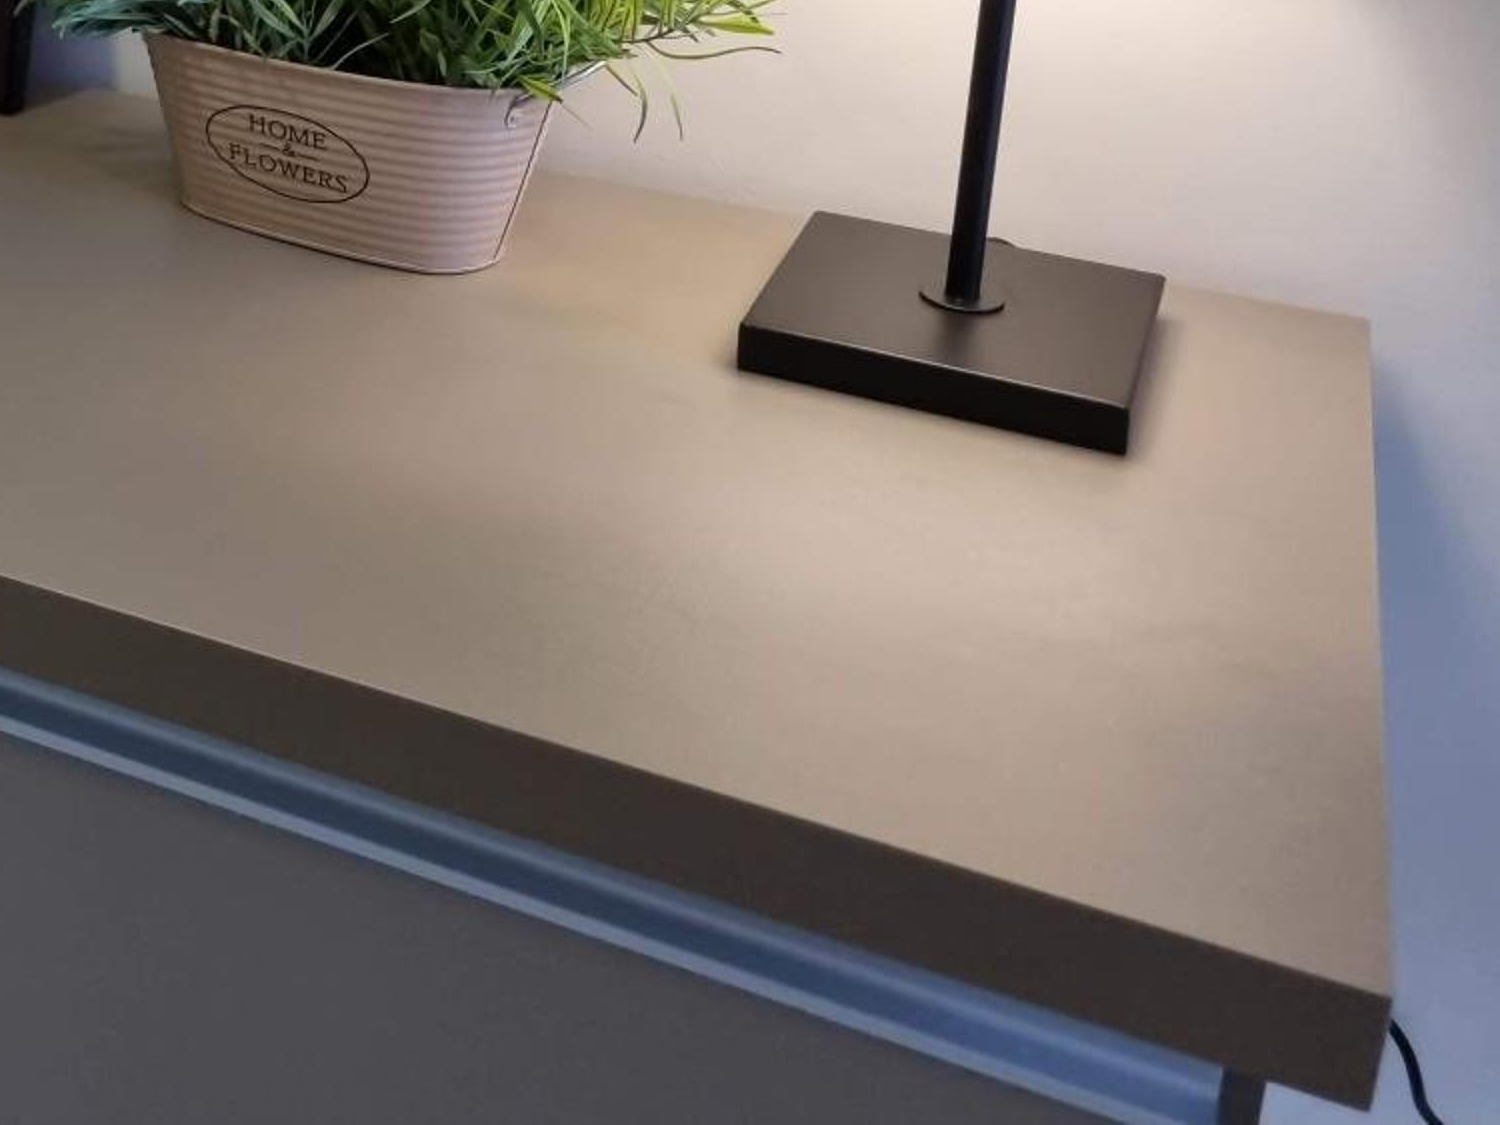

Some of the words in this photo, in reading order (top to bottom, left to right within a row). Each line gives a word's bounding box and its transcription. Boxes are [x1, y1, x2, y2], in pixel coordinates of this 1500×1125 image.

[249, 114, 327, 150] HOME
[282, 142, 297, 158] &
[229, 142, 348, 193] FLOWERS
